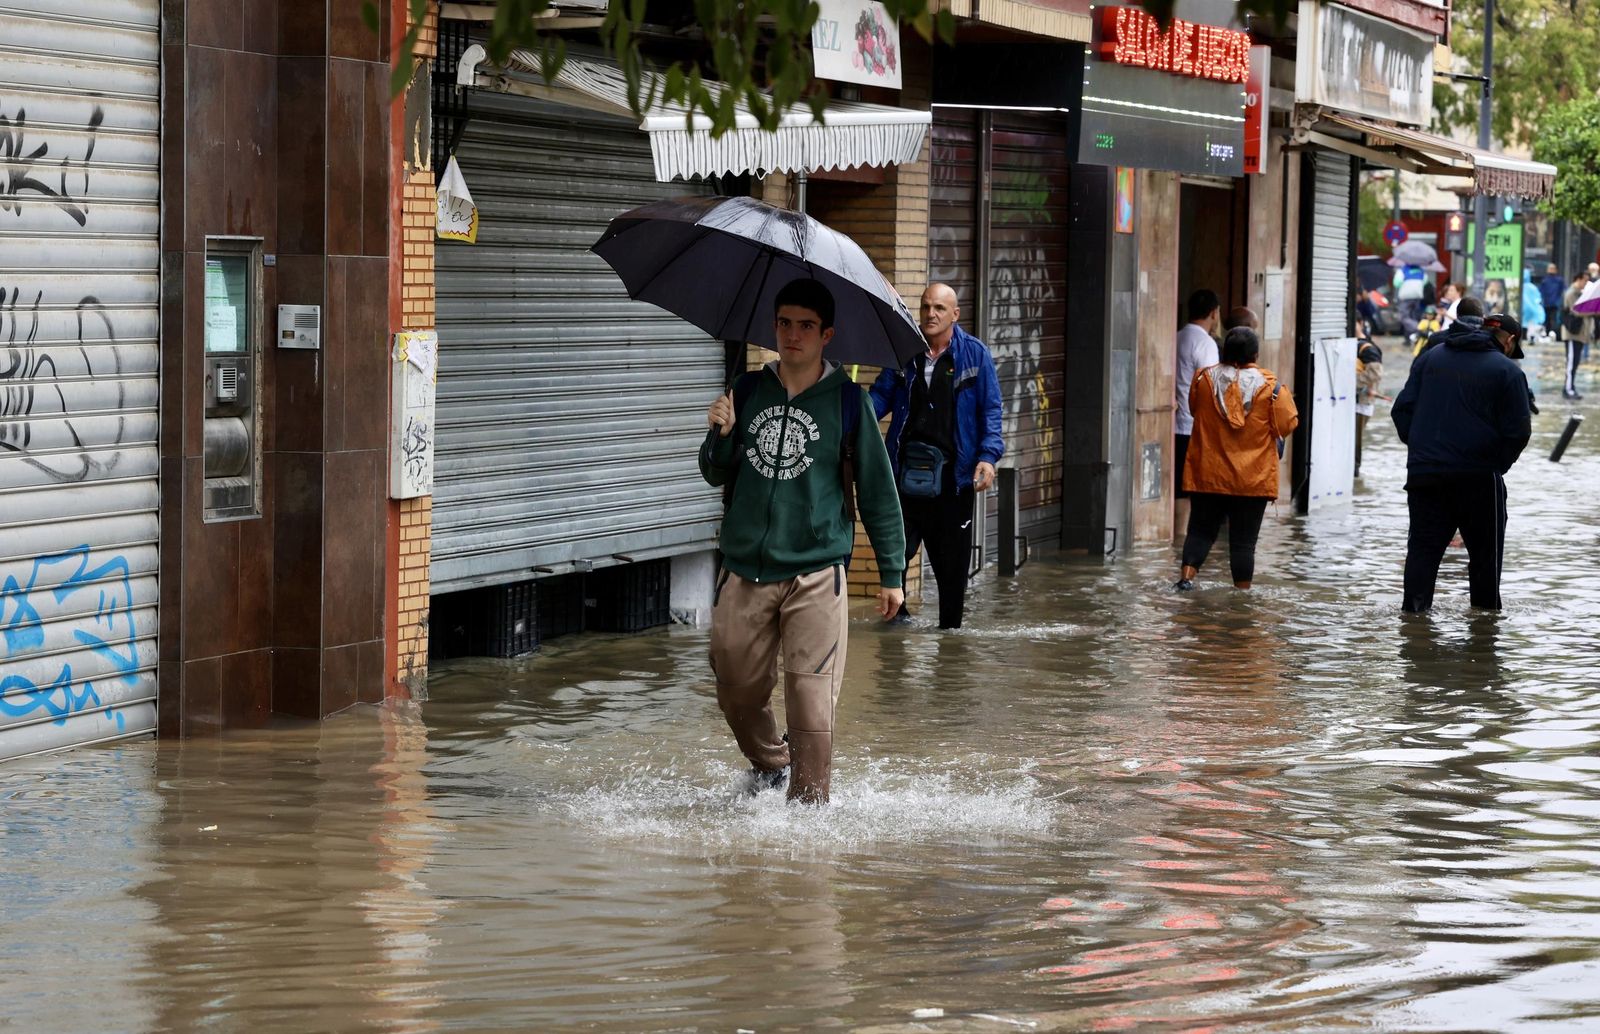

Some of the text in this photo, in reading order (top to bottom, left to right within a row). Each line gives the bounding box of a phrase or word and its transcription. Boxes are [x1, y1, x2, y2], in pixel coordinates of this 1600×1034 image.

[1173, 19, 1194, 74] DE
[1195, 25, 1251, 83] JUEGOS
[1485, 255, 1513, 272] RUSH
[748, 405, 820, 440] UNIVERSIDAD
[745, 447, 814, 480] SALAMANCA
